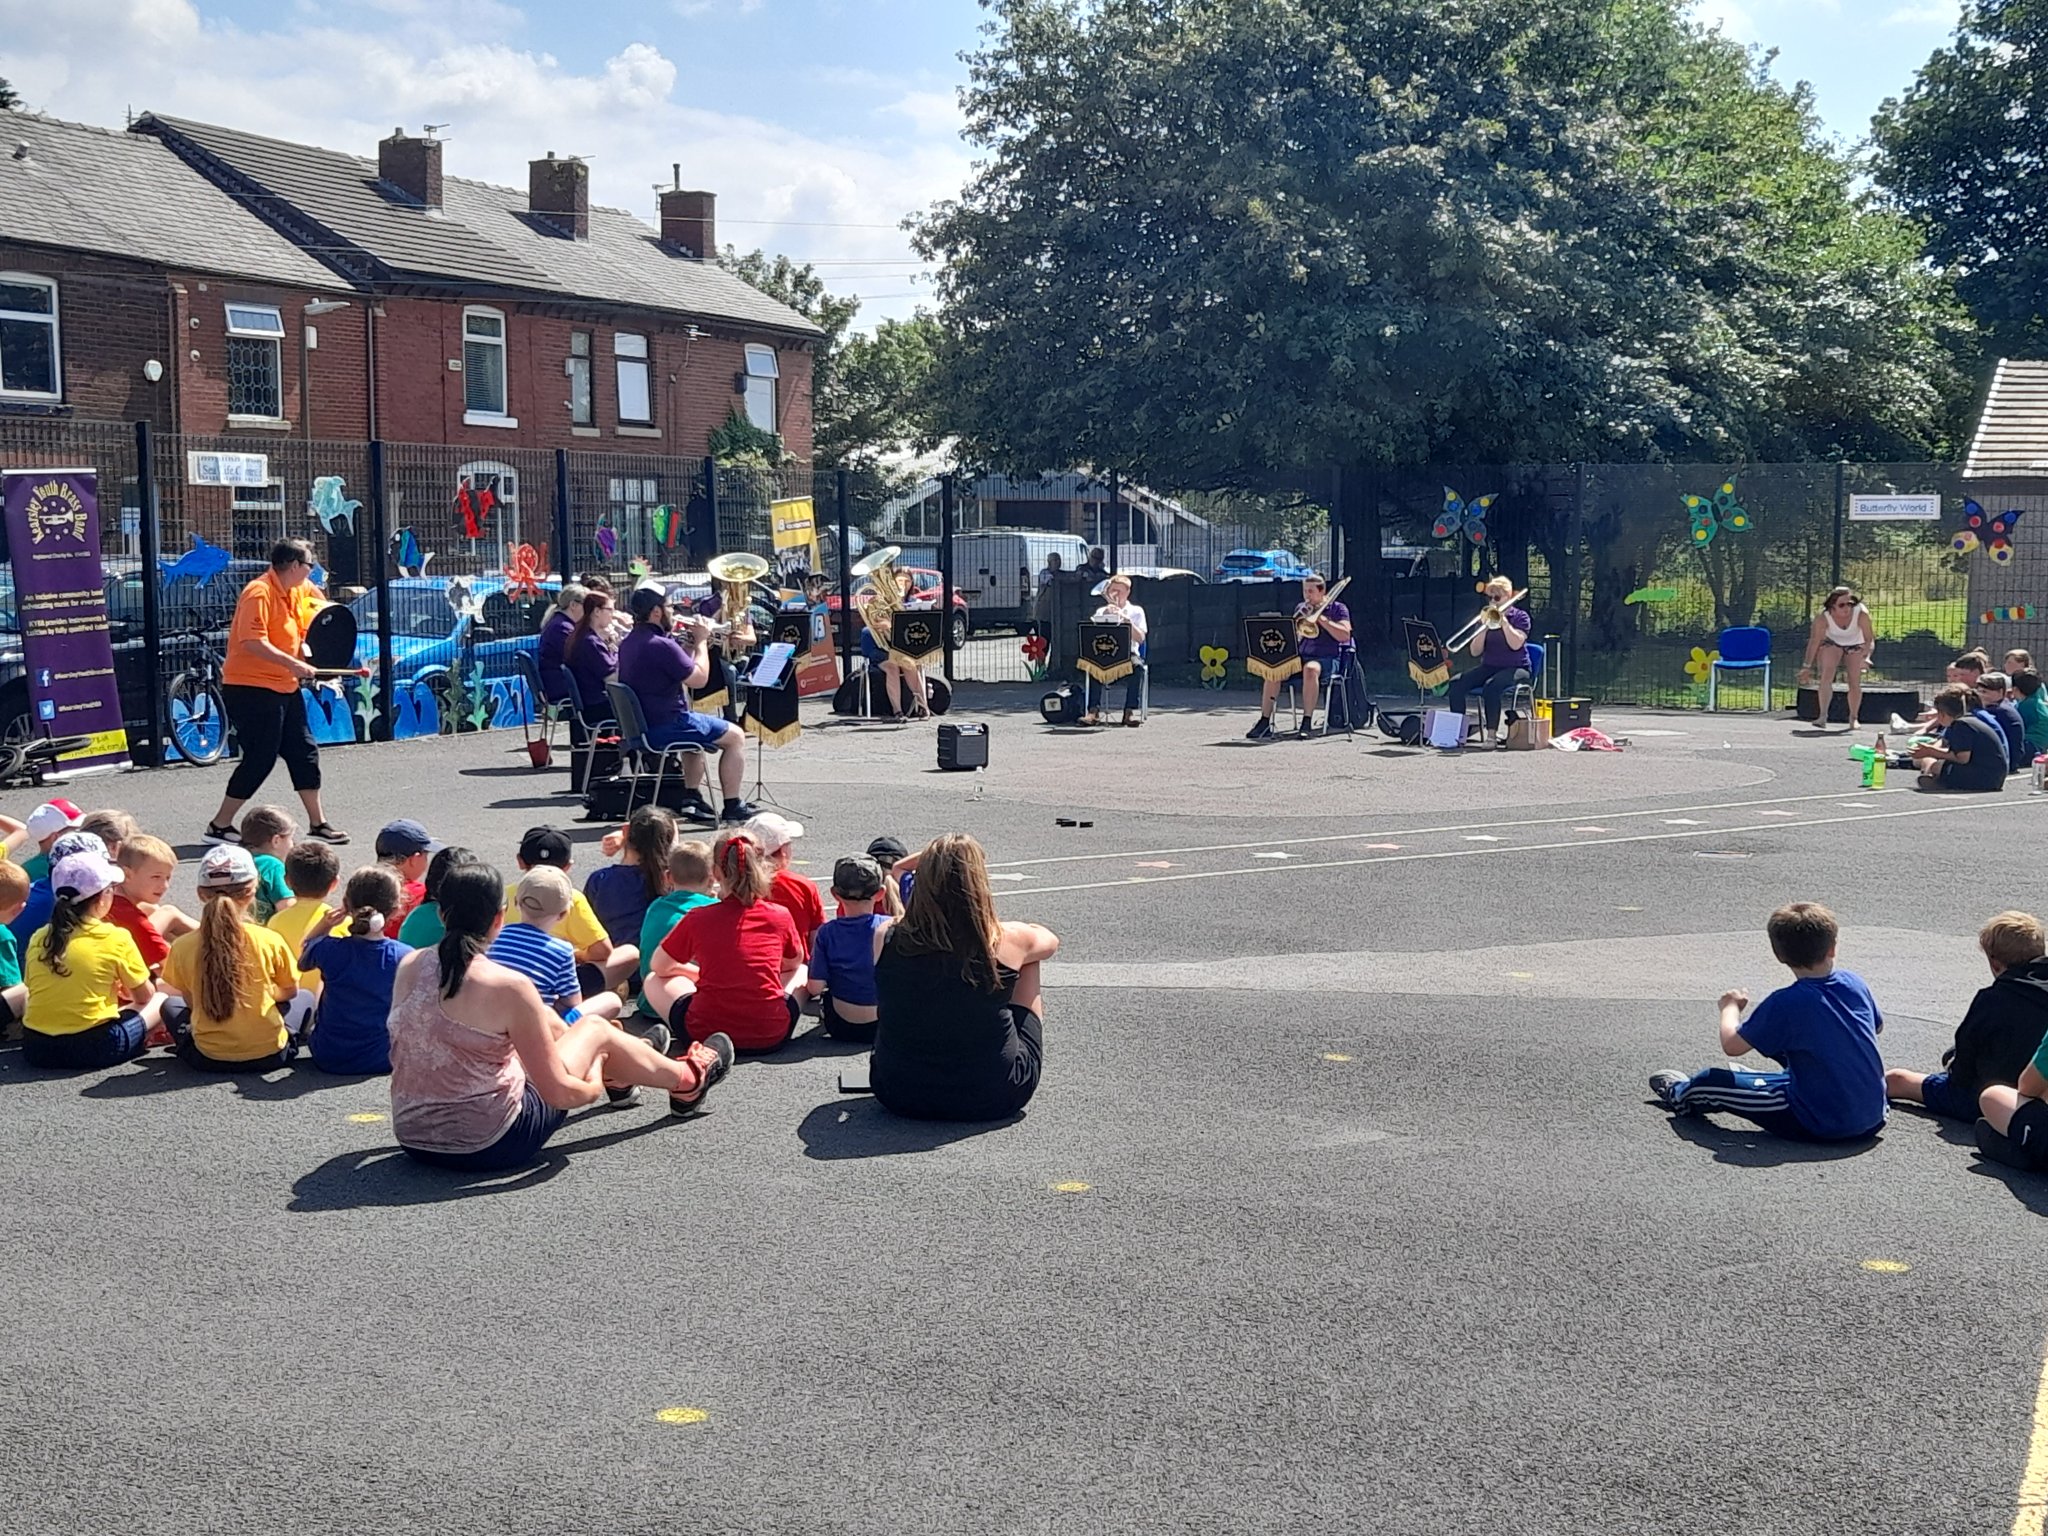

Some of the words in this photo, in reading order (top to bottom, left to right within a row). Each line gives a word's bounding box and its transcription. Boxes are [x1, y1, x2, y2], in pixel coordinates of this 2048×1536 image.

[203, 465, 217, 475] Sea
[32, 480, 59, 501] Youth
[60, 482, 82, 511] Brass
[1860, 503, 1897, 513] Butterfly
[1899, 504, 1927, 512] World
[25, 497, 44, 544] Kearsley
[73, 513, 88, 542] Band
[55, 626, 68, 634] fully
[68, 624, 94, 633] qualified
